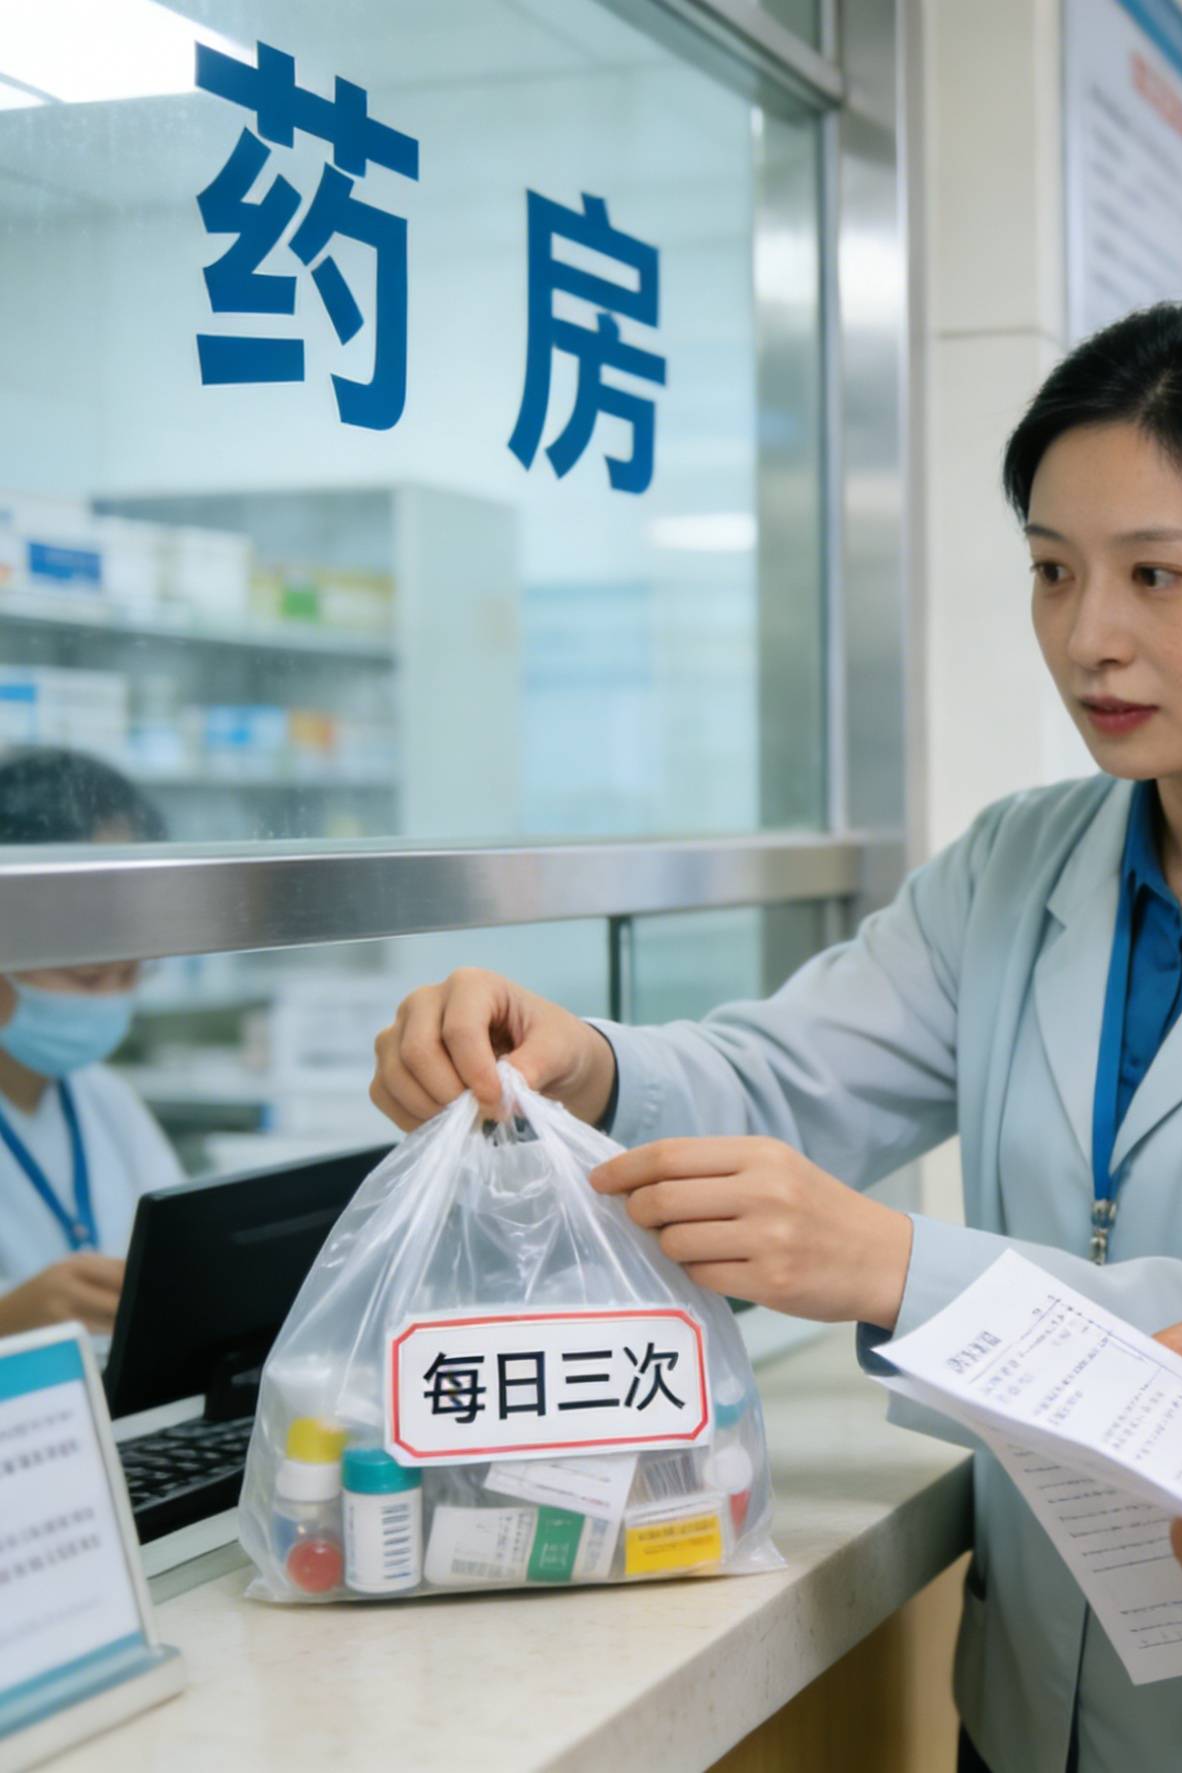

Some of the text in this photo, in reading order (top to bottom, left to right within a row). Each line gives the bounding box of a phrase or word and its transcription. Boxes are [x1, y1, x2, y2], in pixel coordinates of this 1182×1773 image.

[195, 40, 667, 494] 药房
[424, 1342, 686, 1424] 每日三次
